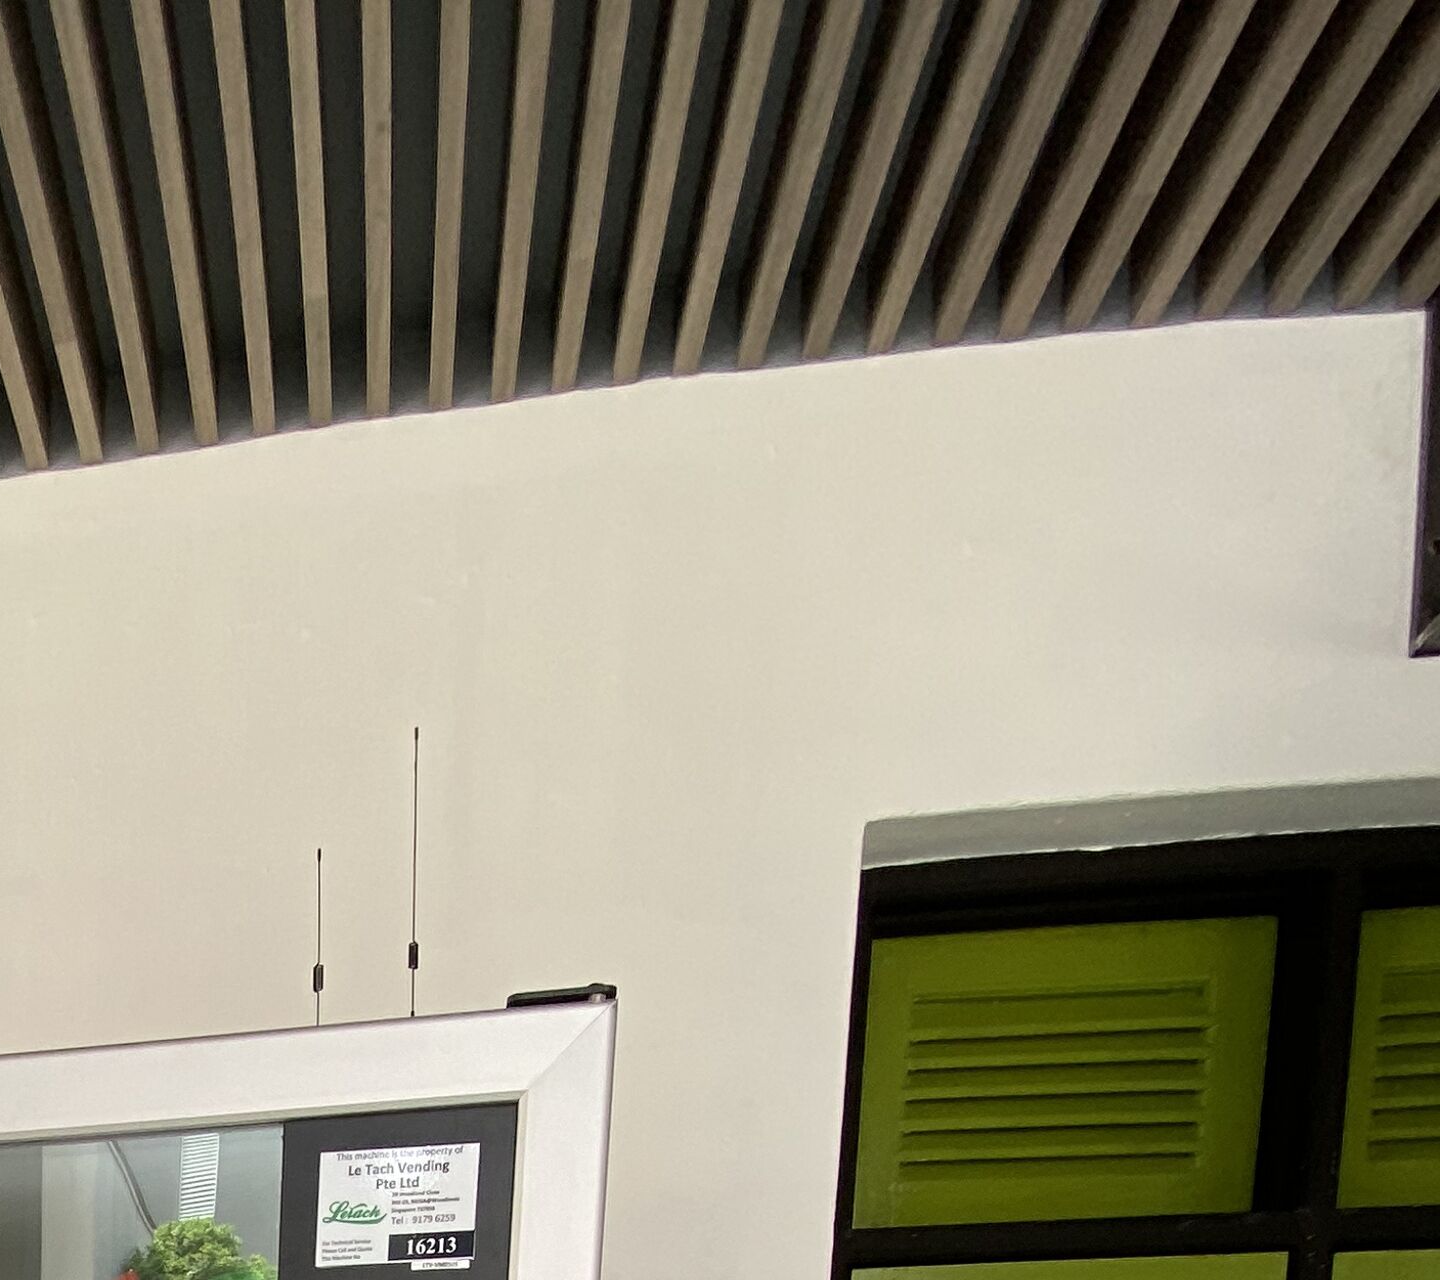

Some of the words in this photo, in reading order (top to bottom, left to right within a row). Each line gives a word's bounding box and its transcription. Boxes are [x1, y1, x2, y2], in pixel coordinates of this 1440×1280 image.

[337, 1153, 353, 1161] This
[355, 1151, 390, 1160] machine
[416, 1147, 452, 1159] property
[454, 1146, 464, 1154] of
[348, 1165, 361, 1176] Le
[365, 1163, 394, 1176] Tach
[398, 1161, 450, 1173] Vending
[376, 1179, 396, 1190] Pte
[400, 1177, 420, 1188] Ltd
[407, 1237, 457, 1255] 16213
